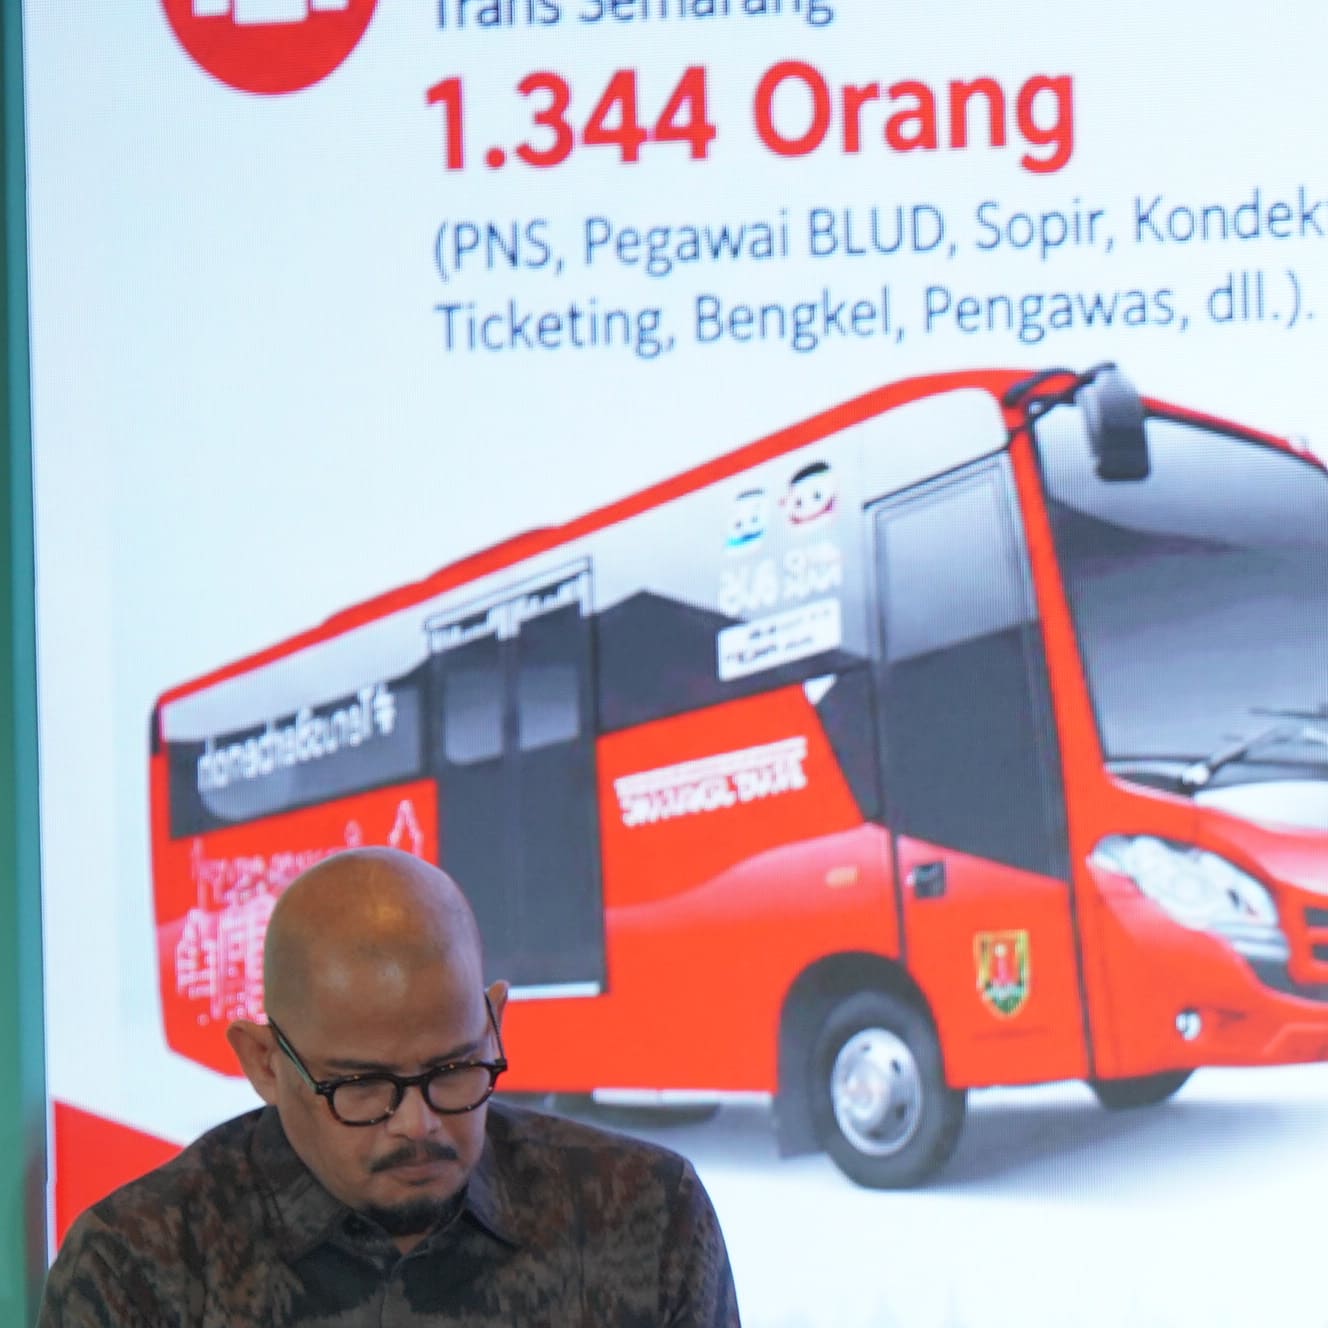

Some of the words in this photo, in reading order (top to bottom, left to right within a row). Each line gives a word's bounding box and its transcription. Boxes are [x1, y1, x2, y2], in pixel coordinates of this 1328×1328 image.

[424, 64, 717, 171] 1.344
[752, 58, 1075, 174] Orang
[433, 219, 564, 278] (PNS,
[583, 208, 790, 277] Pegawai
[807, 203, 957, 259] BLUD,
[974, 196, 1114, 262] Sopir,
[434, 298, 675, 360] Ticketing,
[694, 285, 906, 355] Bengkel,
[924, 283, 1190, 347] Pengawas,
[1206, 270, 1314, 330] dll.).
